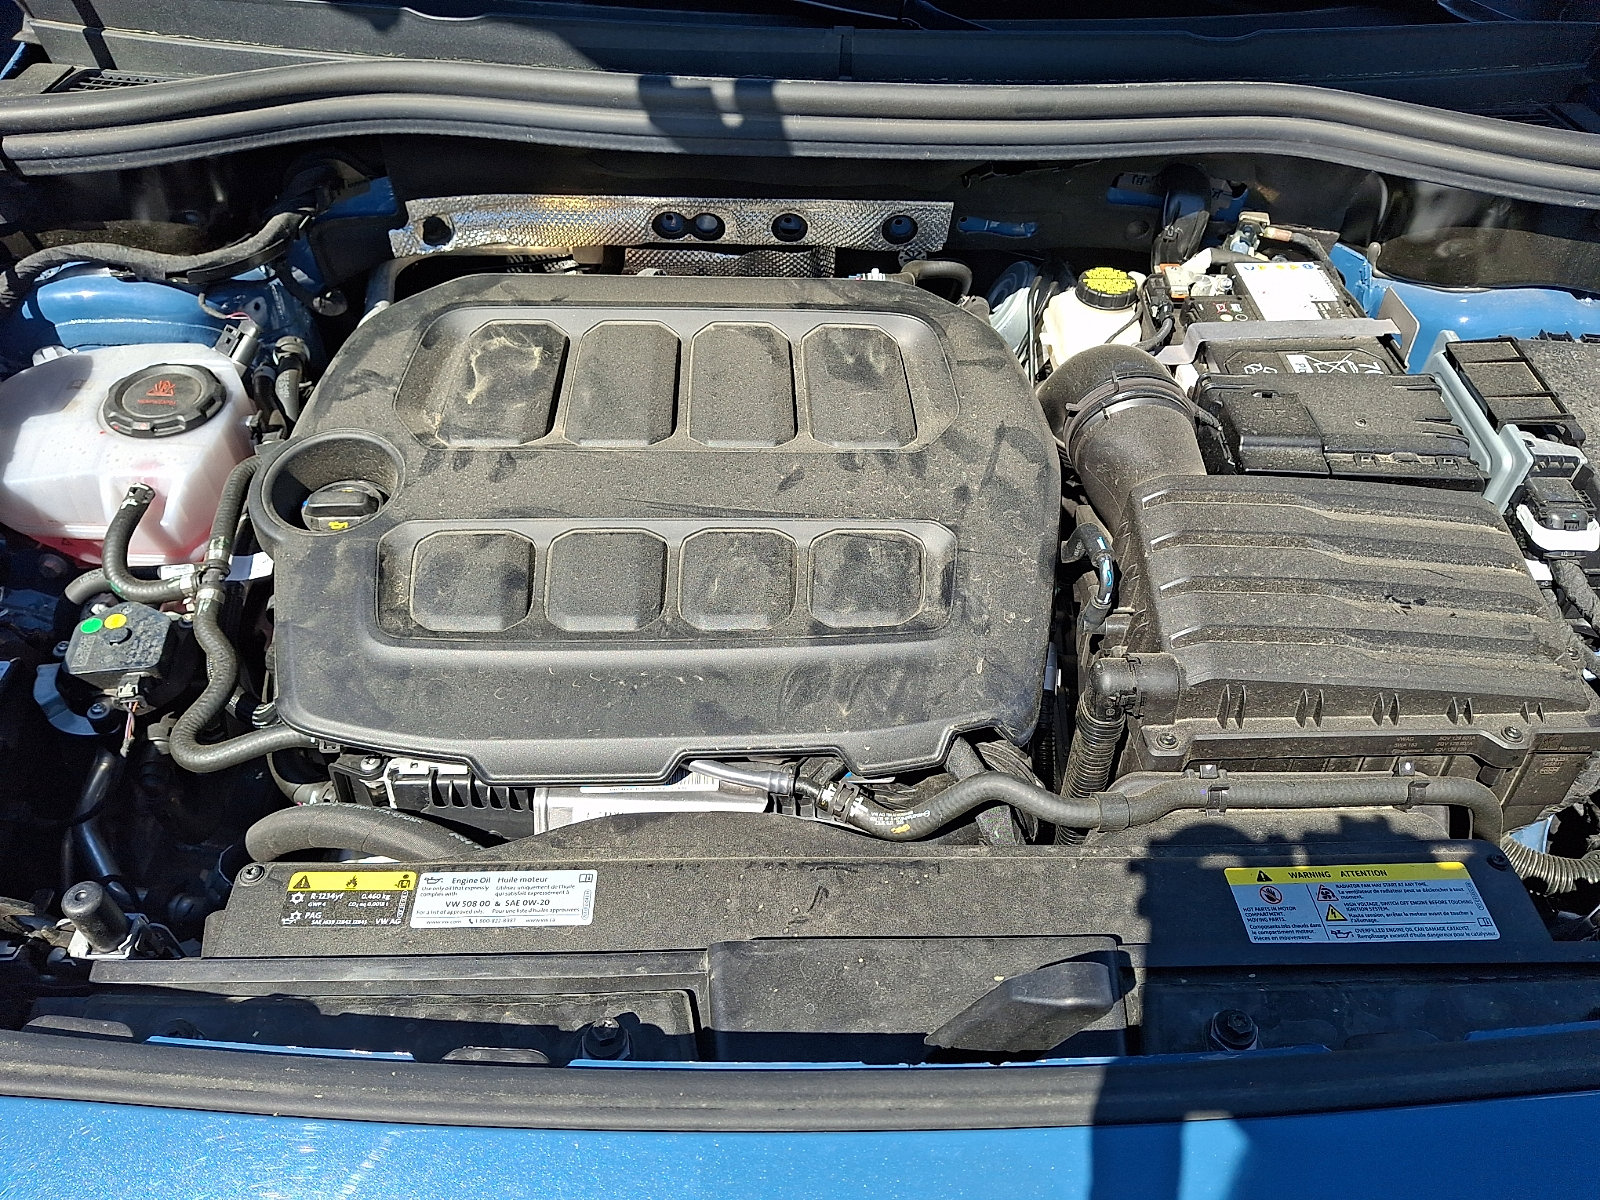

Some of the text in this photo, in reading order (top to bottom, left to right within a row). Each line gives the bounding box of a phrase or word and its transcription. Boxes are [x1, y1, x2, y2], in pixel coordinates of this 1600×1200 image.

[452, 877, 478, 885] Engine
[310, 893, 344, 902] R-1234yf
[382, 894, 391, 902] kg
